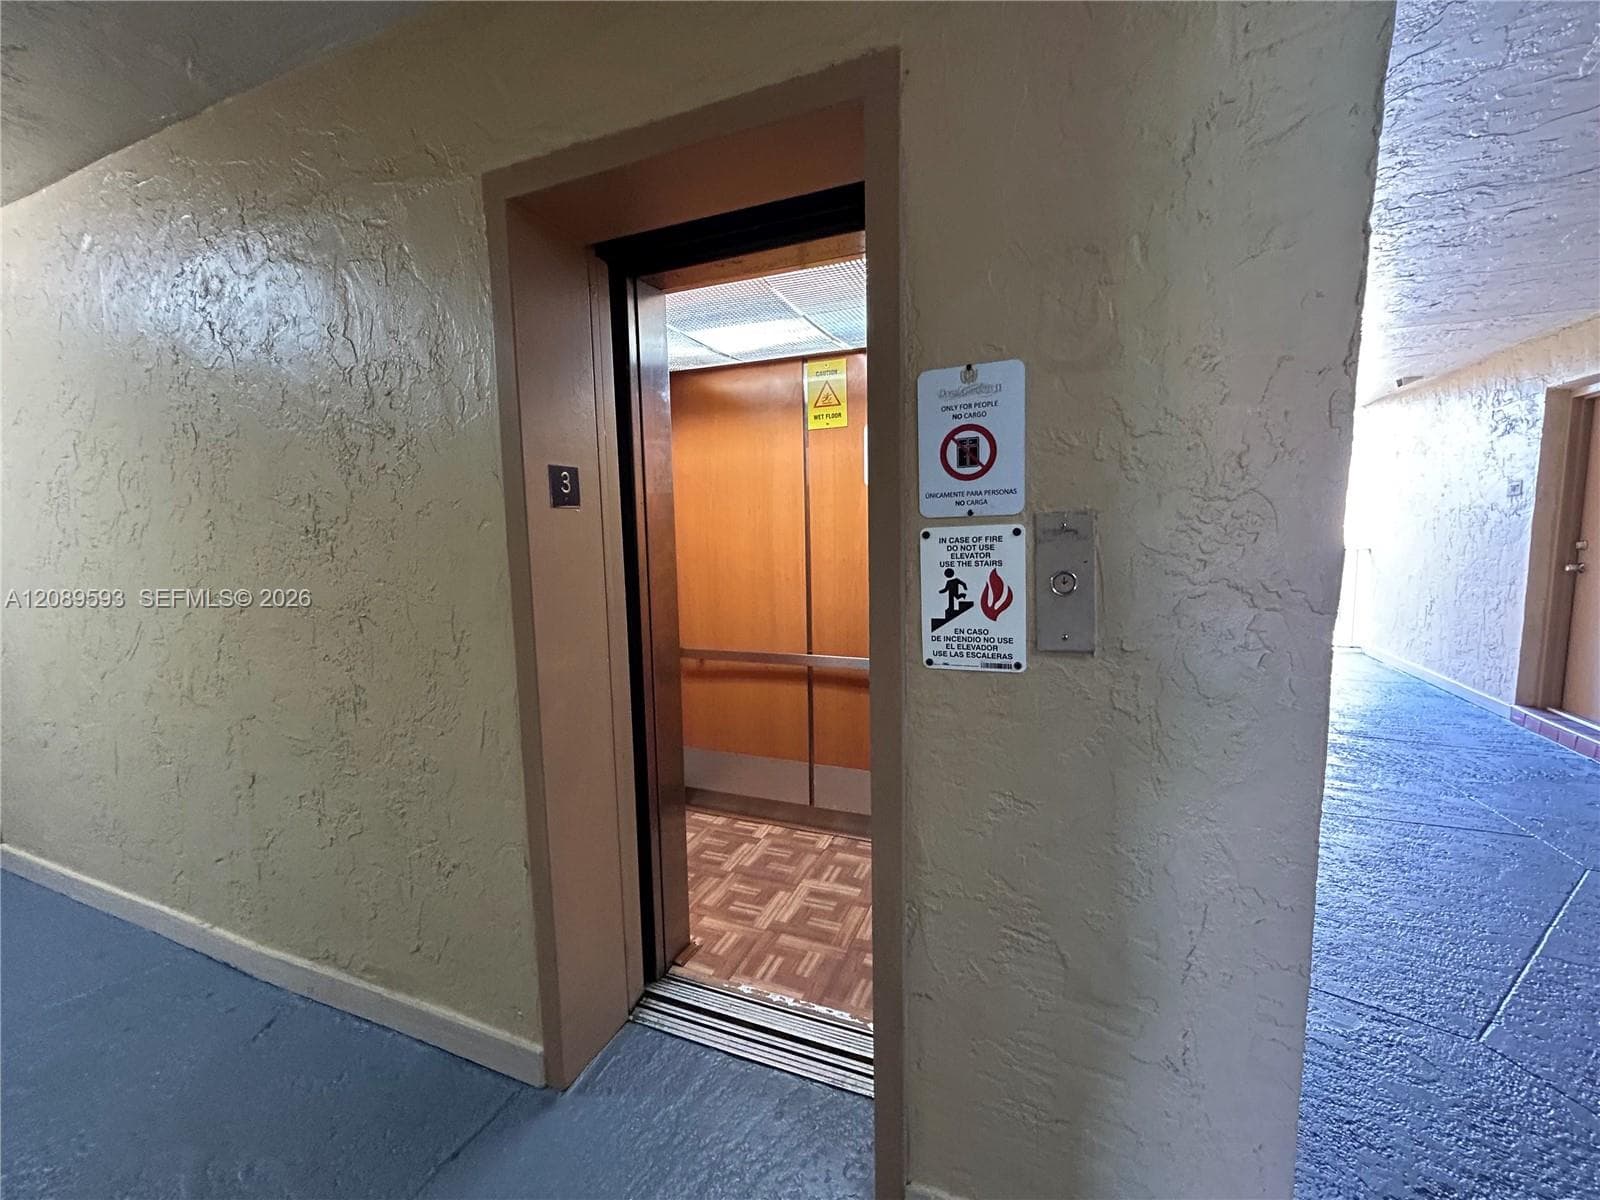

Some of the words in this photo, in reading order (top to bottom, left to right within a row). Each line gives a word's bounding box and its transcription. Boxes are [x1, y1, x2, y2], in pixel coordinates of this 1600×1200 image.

[941, 404, 958, 412] ONLY
[974, 400, 999, 408] PEOPLE
[964, 410, 987, 419] CARGO
[561, 471, 571, 493] 3
[984, 488, 1018, 496] PERSONAS
[957, 644, 998, 652] ELEVADOR
[966, 652, 1013, 660] ESCALERAS
